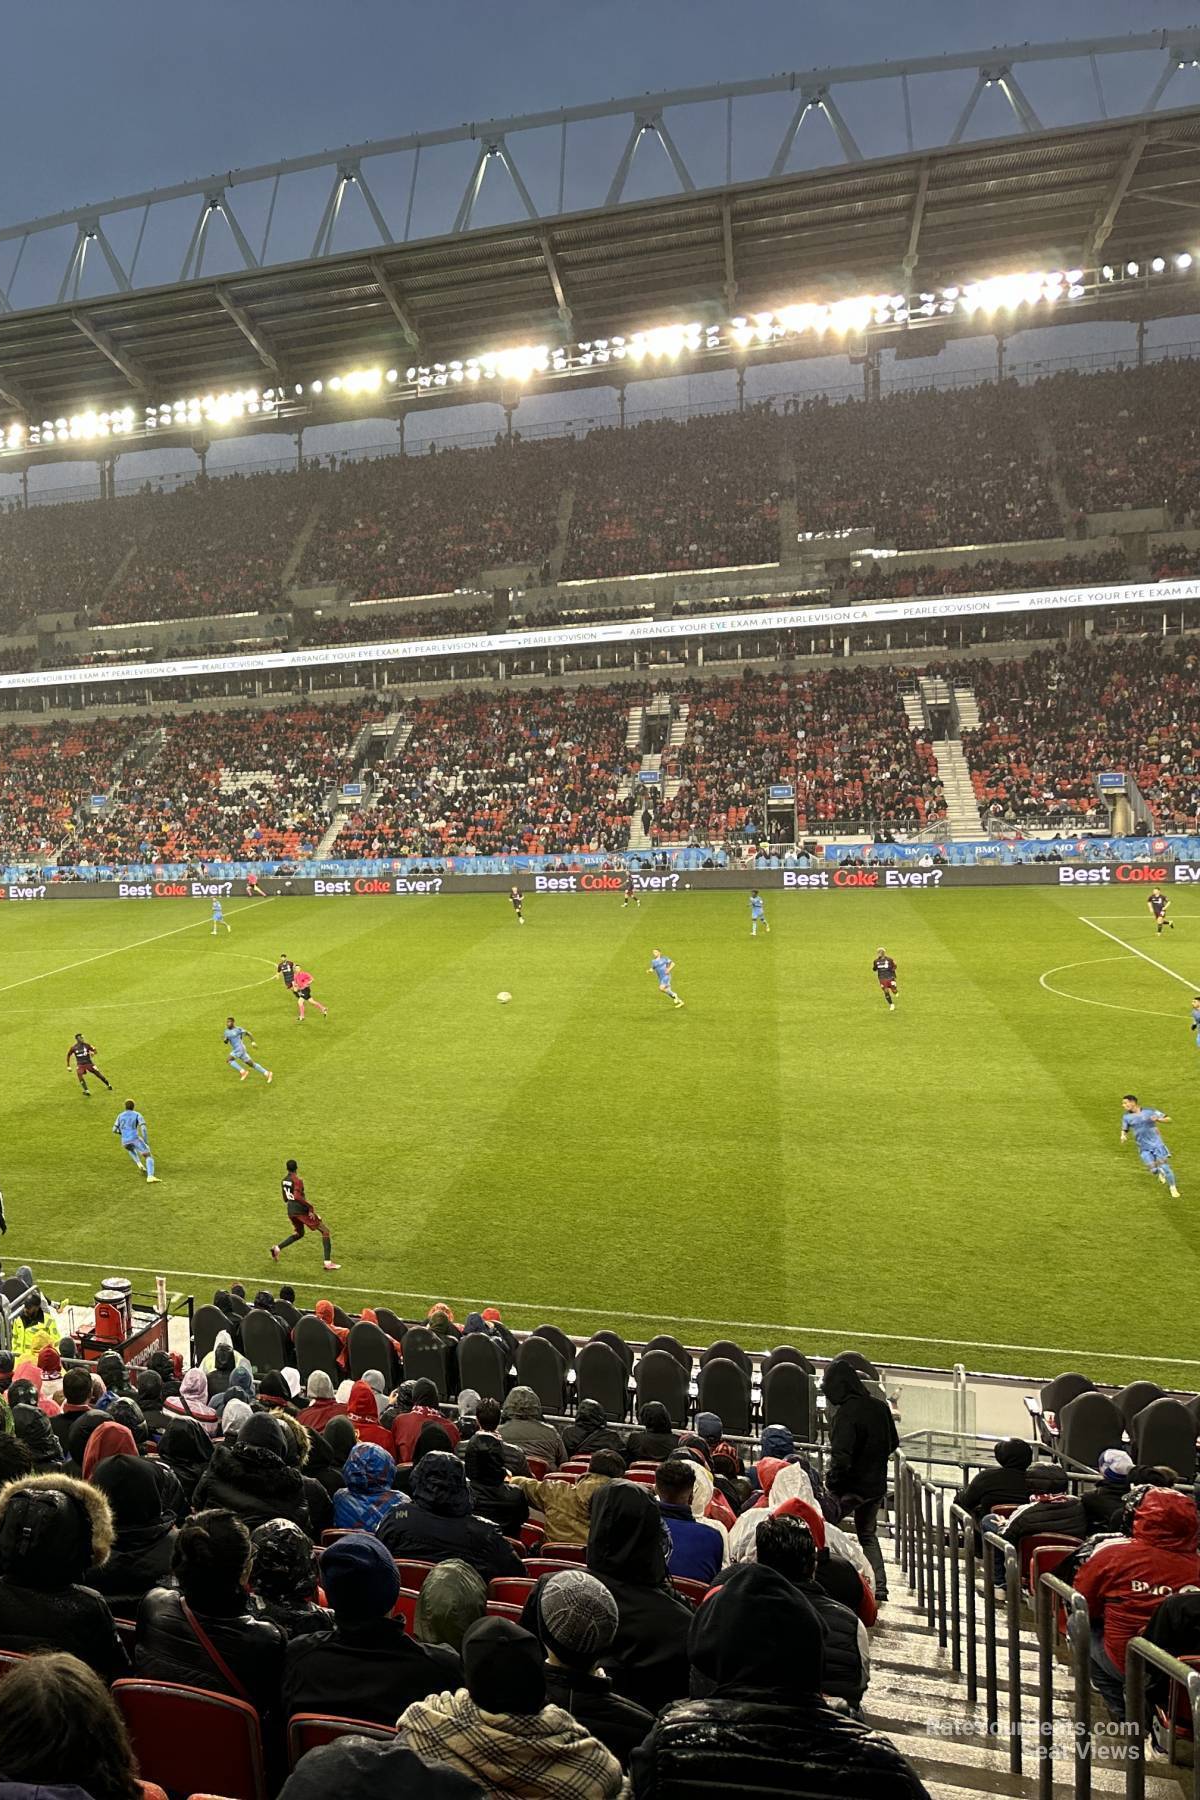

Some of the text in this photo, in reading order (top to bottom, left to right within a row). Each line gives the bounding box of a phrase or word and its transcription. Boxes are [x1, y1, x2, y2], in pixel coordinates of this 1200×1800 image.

[1029, 586, 1200, 606] ARRANGE YOUR EYE EXAM AT
[904, 602, 990, 616] PEARLE VISION
[630, 626, 676, 636] ARRANGE
[678, 623, 707, 633] YOUR
[709, 621, 728, 630] EYE
[730, 618, 758, 628] EXAM
[761, 617, 773, 626] AT
[524, 632, 597, 645] PEARLE VISION
[291, 654, 330, 664] ARRANGE
[332, 652, 356, 660] YOUR
[358, 650, 374, 658] EYE
[376, 648, 399, 658] EXAM
[402, 647, 412, 655] AT
[202, 660, 264, 671] PEARLE VISION
[8, 676, 40, 686] ARRANGE
[42, 674, 63, 684] YOUR
[64, 674, 78, 682] EYE
[79, 672, 100, 681] EXAM
[976, 846, 1000, 854] BMO
[784, 869, 943, 887] Best Coke Ever?
[1059, 866, 1110, 882] Best
[1116, 864, 1168, 882] Coke
[118, 882, 232, 897] Best Coke Ever?
[314, 878, 442, 894] Best Coke Ever?
[535, 876, 576, 890] Best
[580, 874, 622, 890] Coke
[9, 886, 46, 898] Ever?
[1131, 1580, 1173, 1596] BMO
